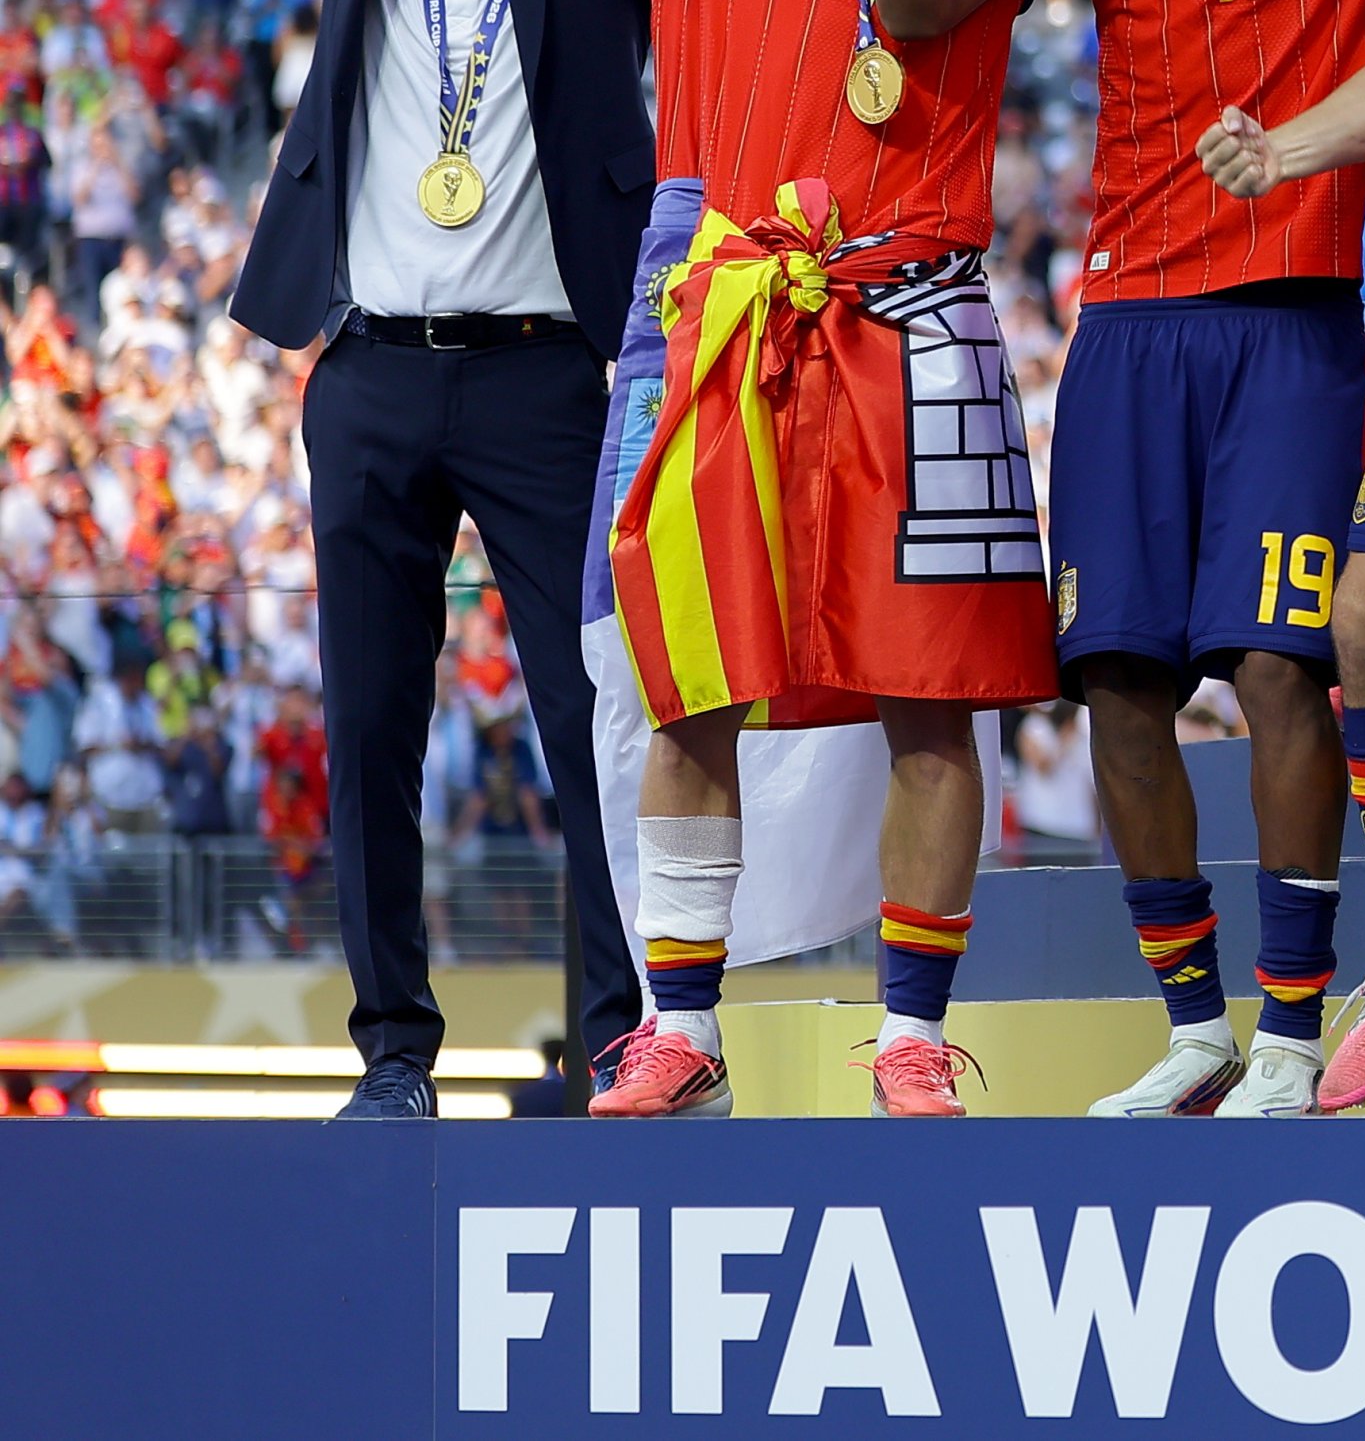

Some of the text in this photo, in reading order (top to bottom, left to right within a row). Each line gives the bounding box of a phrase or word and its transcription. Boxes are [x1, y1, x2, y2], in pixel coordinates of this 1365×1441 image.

[430, 25, 441, 50] CUP
[1259, 533, 1336, 628] 19
[459, 1206, 940, 1416] FIFA
